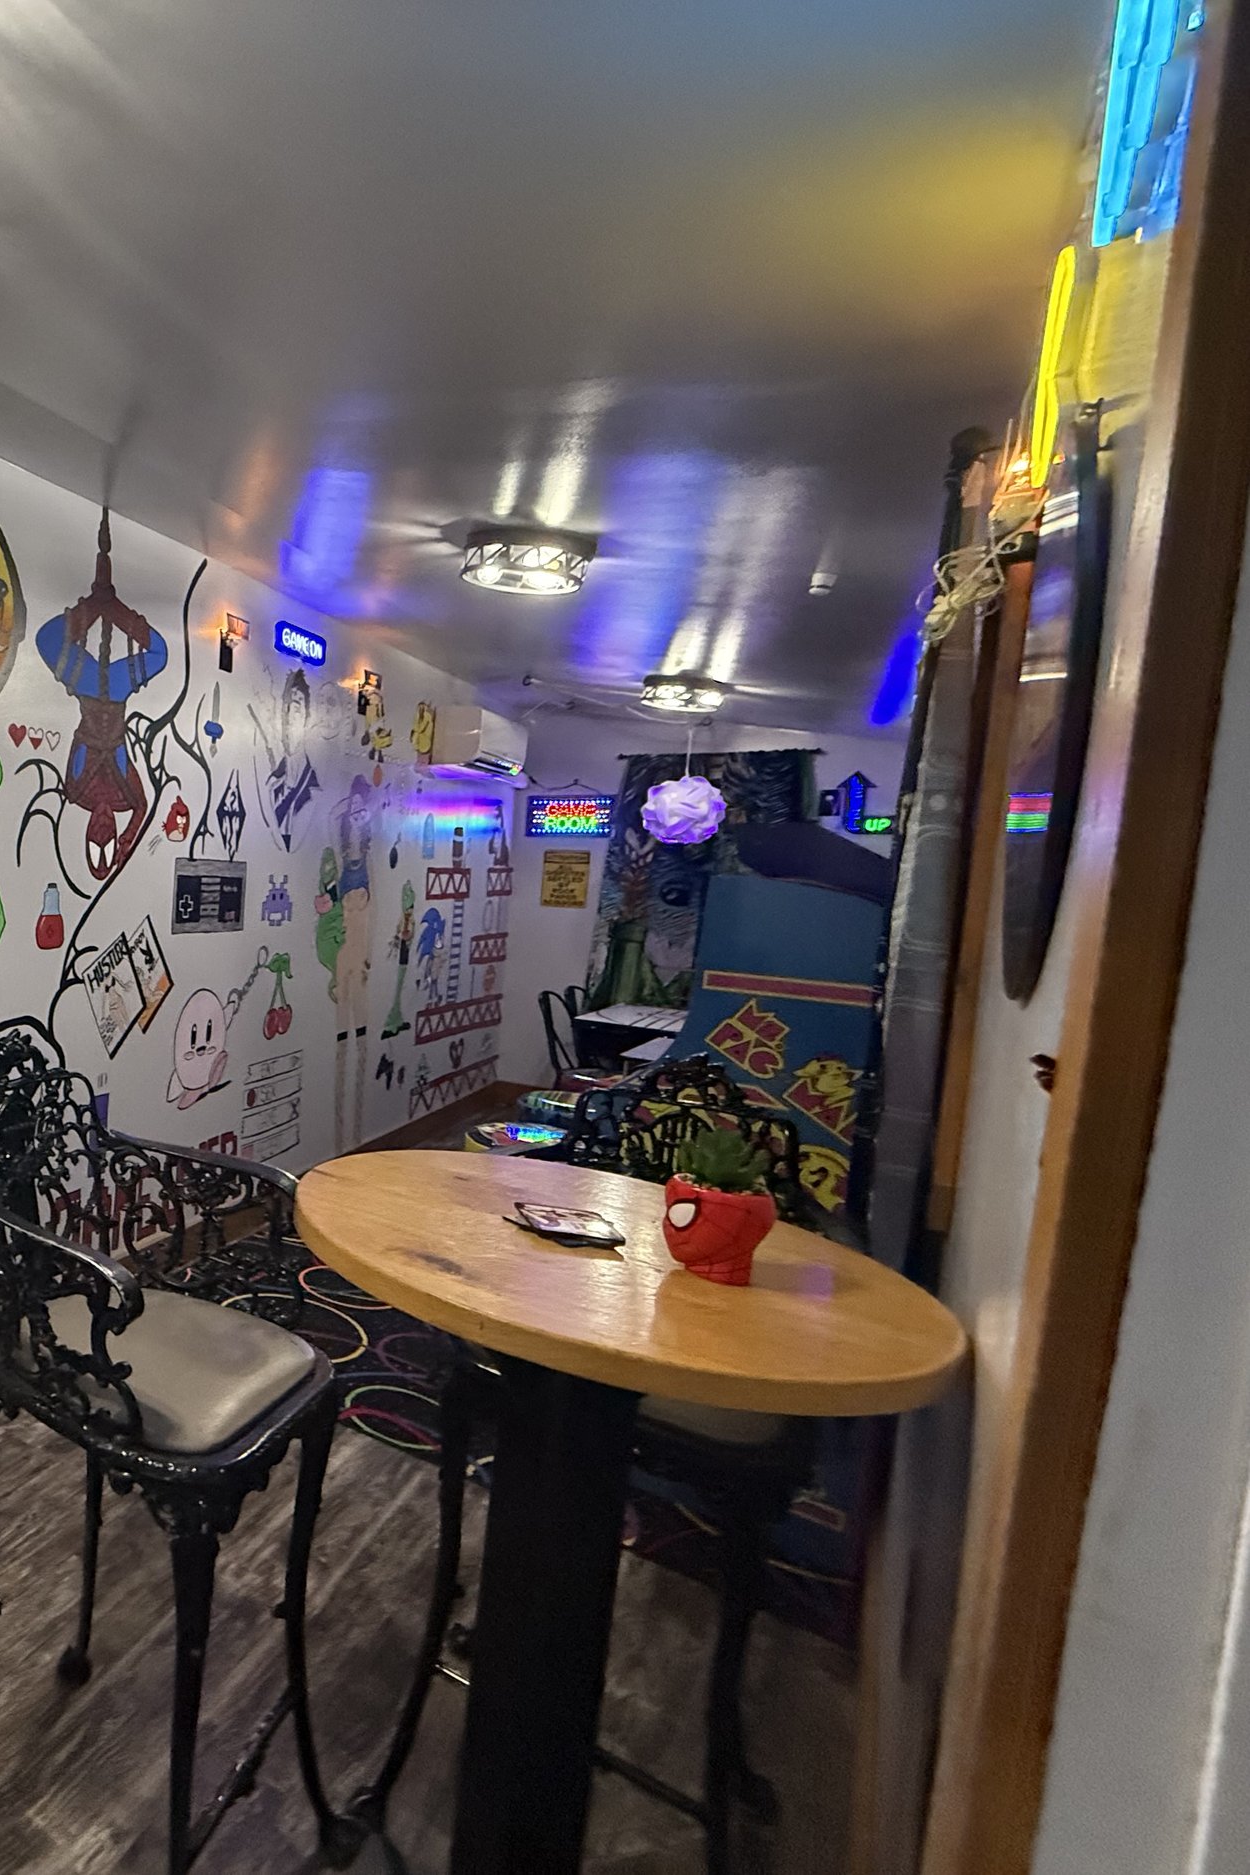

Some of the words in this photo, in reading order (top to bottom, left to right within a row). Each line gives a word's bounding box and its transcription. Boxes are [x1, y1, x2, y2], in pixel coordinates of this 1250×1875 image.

[282, 627, 309, 656] GAME
[310, 640, 323, 659] ON
[546, 804, 597, 816] GAME
[544, 817, 597, 831] ROOM
[864, 818, 892, 832] UP
